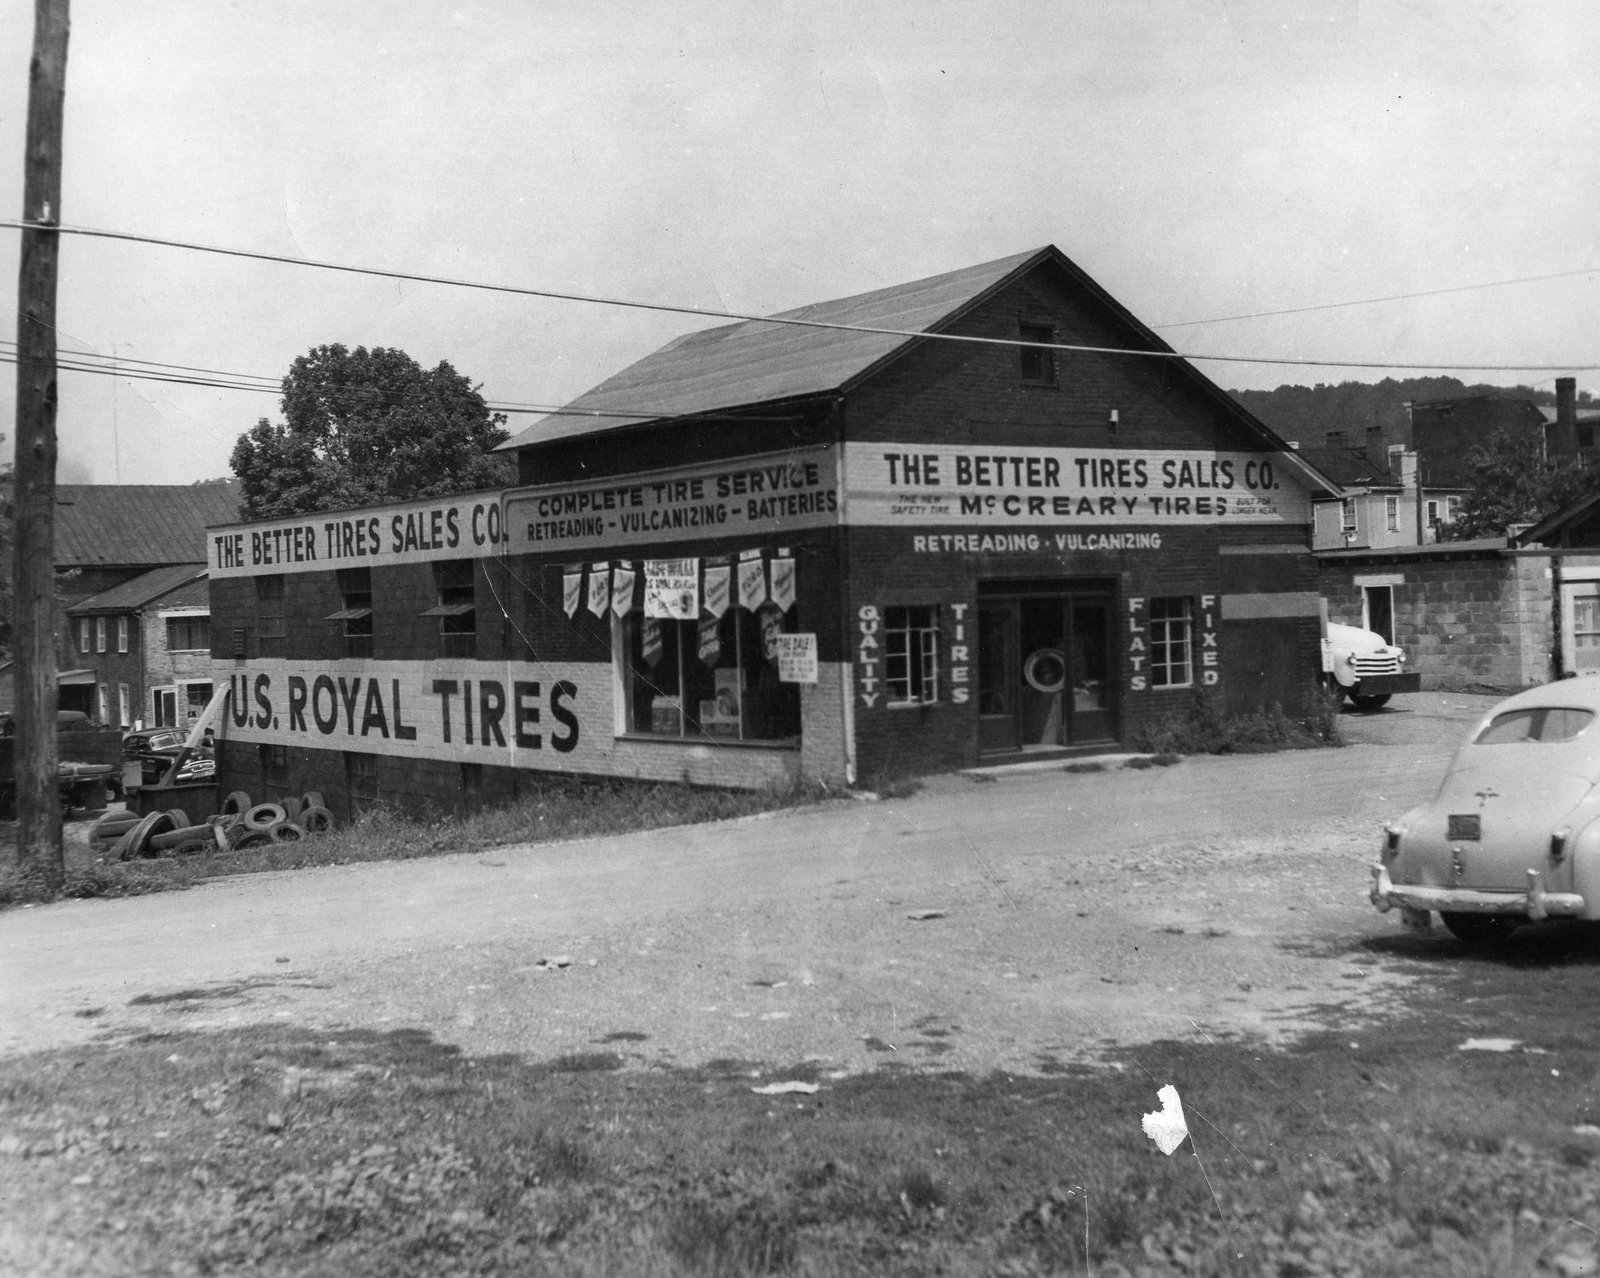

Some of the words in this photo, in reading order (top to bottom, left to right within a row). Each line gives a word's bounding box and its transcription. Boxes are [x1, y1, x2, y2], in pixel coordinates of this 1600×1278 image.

[538, 487, 643, 518] COMPLETE
[653, 478, 703, 504] TIRE
[716, 464, 819, 498] SERVICE
[884, 454, 940, 485] THE
[956, 455, 1060, 487] BETTER
[1075, 458, 1149, 488] TIRES
[1162, 459, 1234, 489] SALES
[1245, 460, 1279, 490] CO.
[215, 534, 244, 568] THE
[252, 526, 316, 566] BETTER
[324, 517, 380, 559] TIRES
[391, 507, 460, 553] SALES
[472, 503, 509, 546] CO.
[527, 516, 603, 541] RETREADING
[620, 504, 727, 533] VULCANIZING
[749, 490, 838, 520] BATTERIES
[1149, 497, 1227, 516] TIRES
[913, 534, 1040, 552] RETREADING
[1055, 532, 1161, 550] VULCANIZING
[858, 605, 880, 709] QUALITY
[951, 603, 969, 703] TIRES
[1128, 598, 1147, 691] FLATS
[1201, 594, 1219, 686] FIXED
[231, 673, 279, 730] U.S.
[288, 674, 417, 741] ROYAL
[432, 679, 580, 753] TIRES
